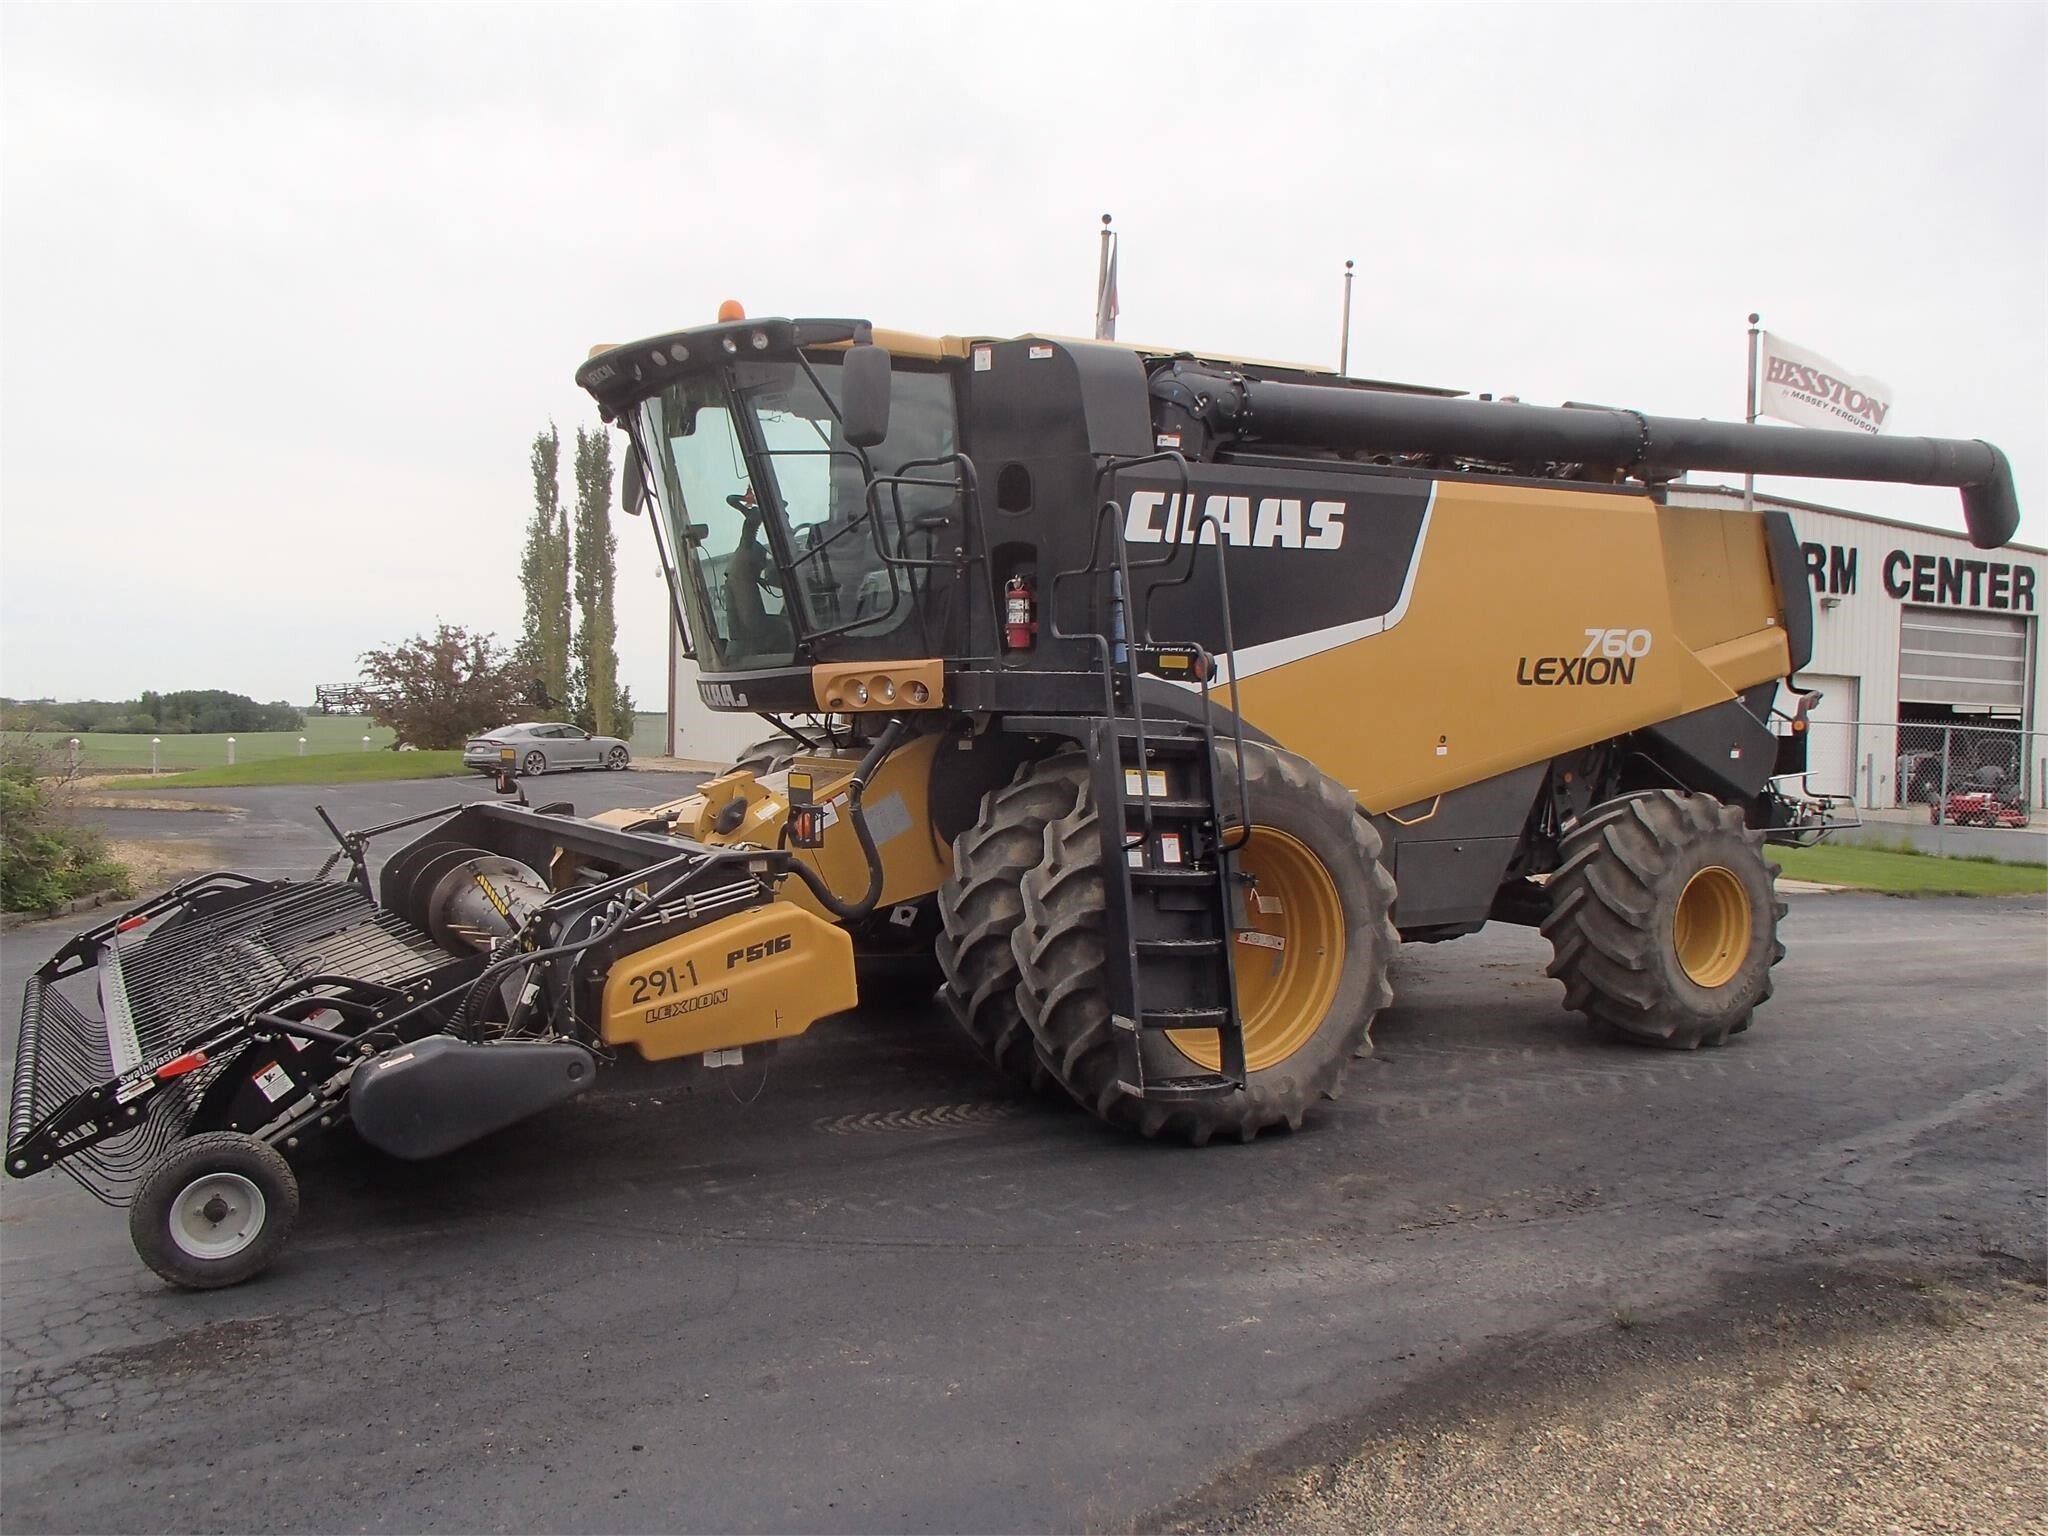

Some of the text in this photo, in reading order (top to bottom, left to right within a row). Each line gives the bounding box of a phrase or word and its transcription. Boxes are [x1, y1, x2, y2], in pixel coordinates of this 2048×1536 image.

[1766, 356, 1889, 425] HESSTON
[1790, 391, 1828, 410] MASSEY
[1830, 406, 1879, 435] FERGUSON
[1124, 491, 1346, 550] CLAAS
[1800, 541, 2036, 611] RM CENTER
[1582, 628, 1653, 658] 760
[1516, 657, 1637, 686] LEXION
[726, 934, 793, 970] P516
[629, 960, 699, 1005] 291-1
[645, 988, 728, 1024] LEXION
[119, 1046, 184, 1086] SwathMaster
